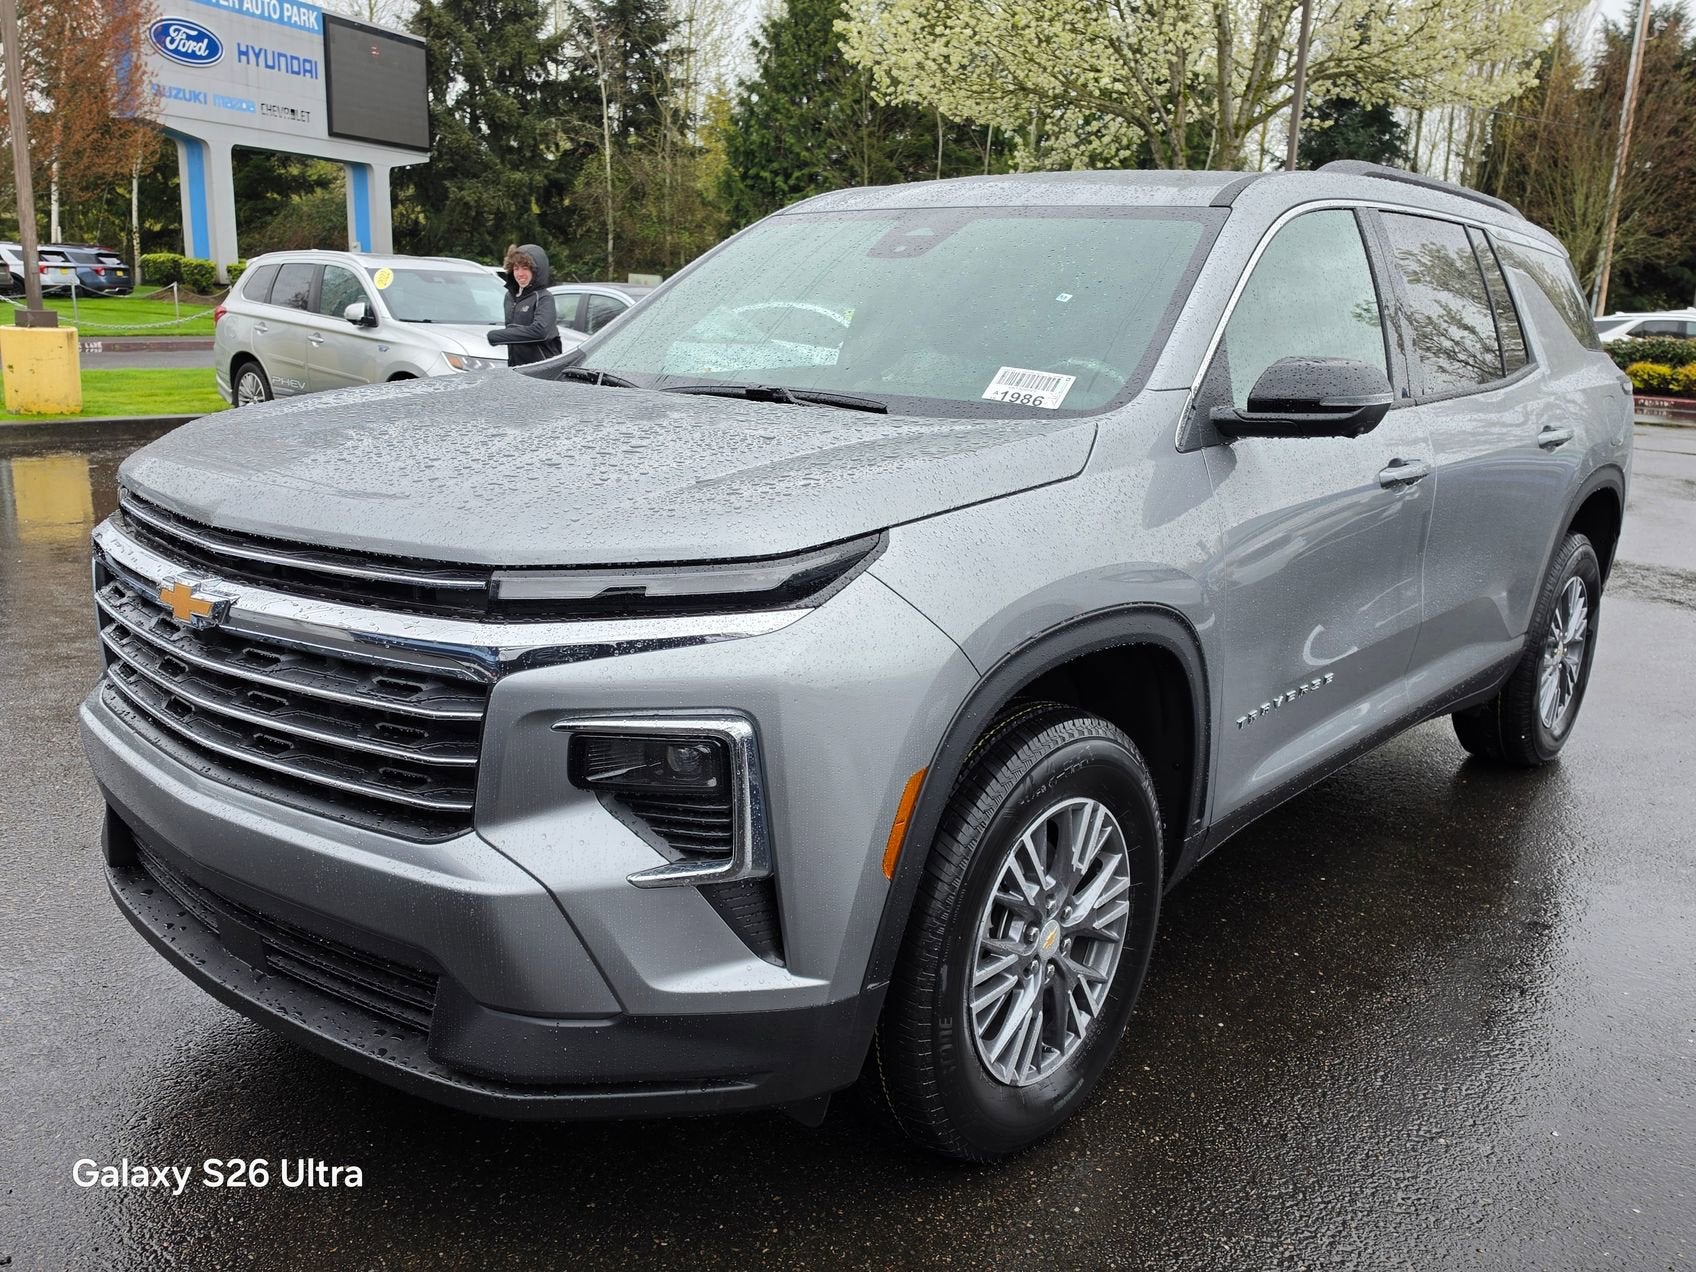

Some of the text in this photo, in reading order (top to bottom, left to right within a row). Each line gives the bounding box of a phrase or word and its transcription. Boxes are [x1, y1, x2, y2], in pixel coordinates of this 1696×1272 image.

[243, 0, 319, 30] AUTO PARK
[165, 25, 209, 56] Ford
[236, 42, 318, 80] HYUNDAI
[261, 103, 311, 123] CHEVROLET
[272, 375, 306, 390] PHEV
[1000, 390, 1045, 407] 1986
[1236, 672, 1334, 729] TRAVERSE
